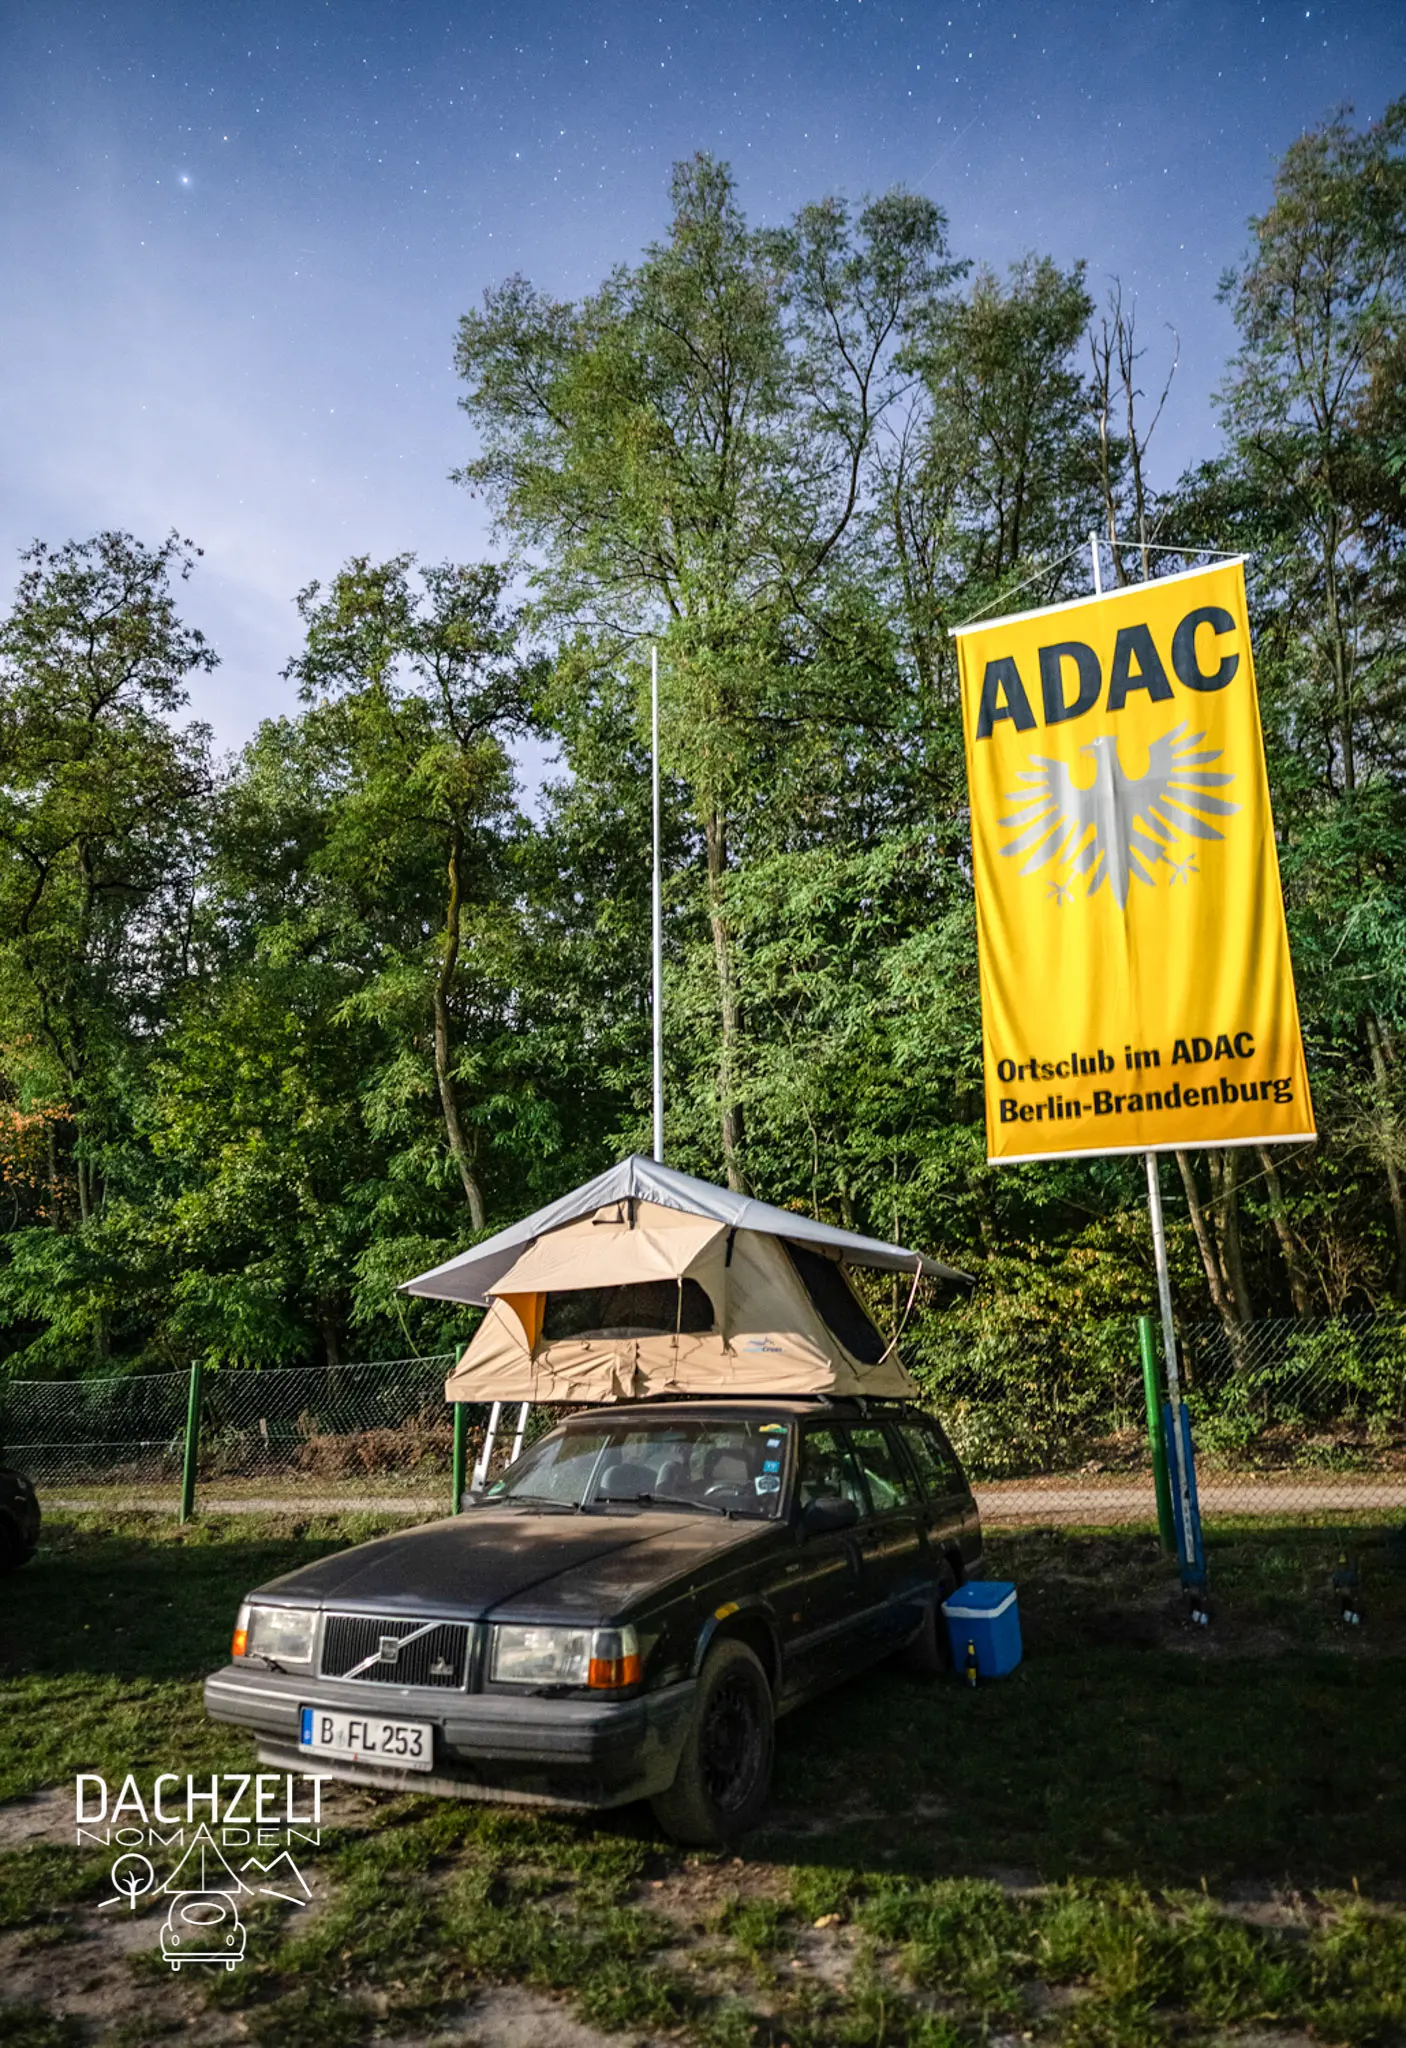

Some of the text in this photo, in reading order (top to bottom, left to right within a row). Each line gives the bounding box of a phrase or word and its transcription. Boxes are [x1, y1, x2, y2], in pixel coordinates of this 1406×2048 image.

[976, 606, 1239, 740] ADAC
[997, 1032, 1255, 1082] Ortsclub im ADAC
[1000, 1077, 1293, 1123] Berlin-Brandenburg
[321, 1717, 423, 1757] B FL 253
